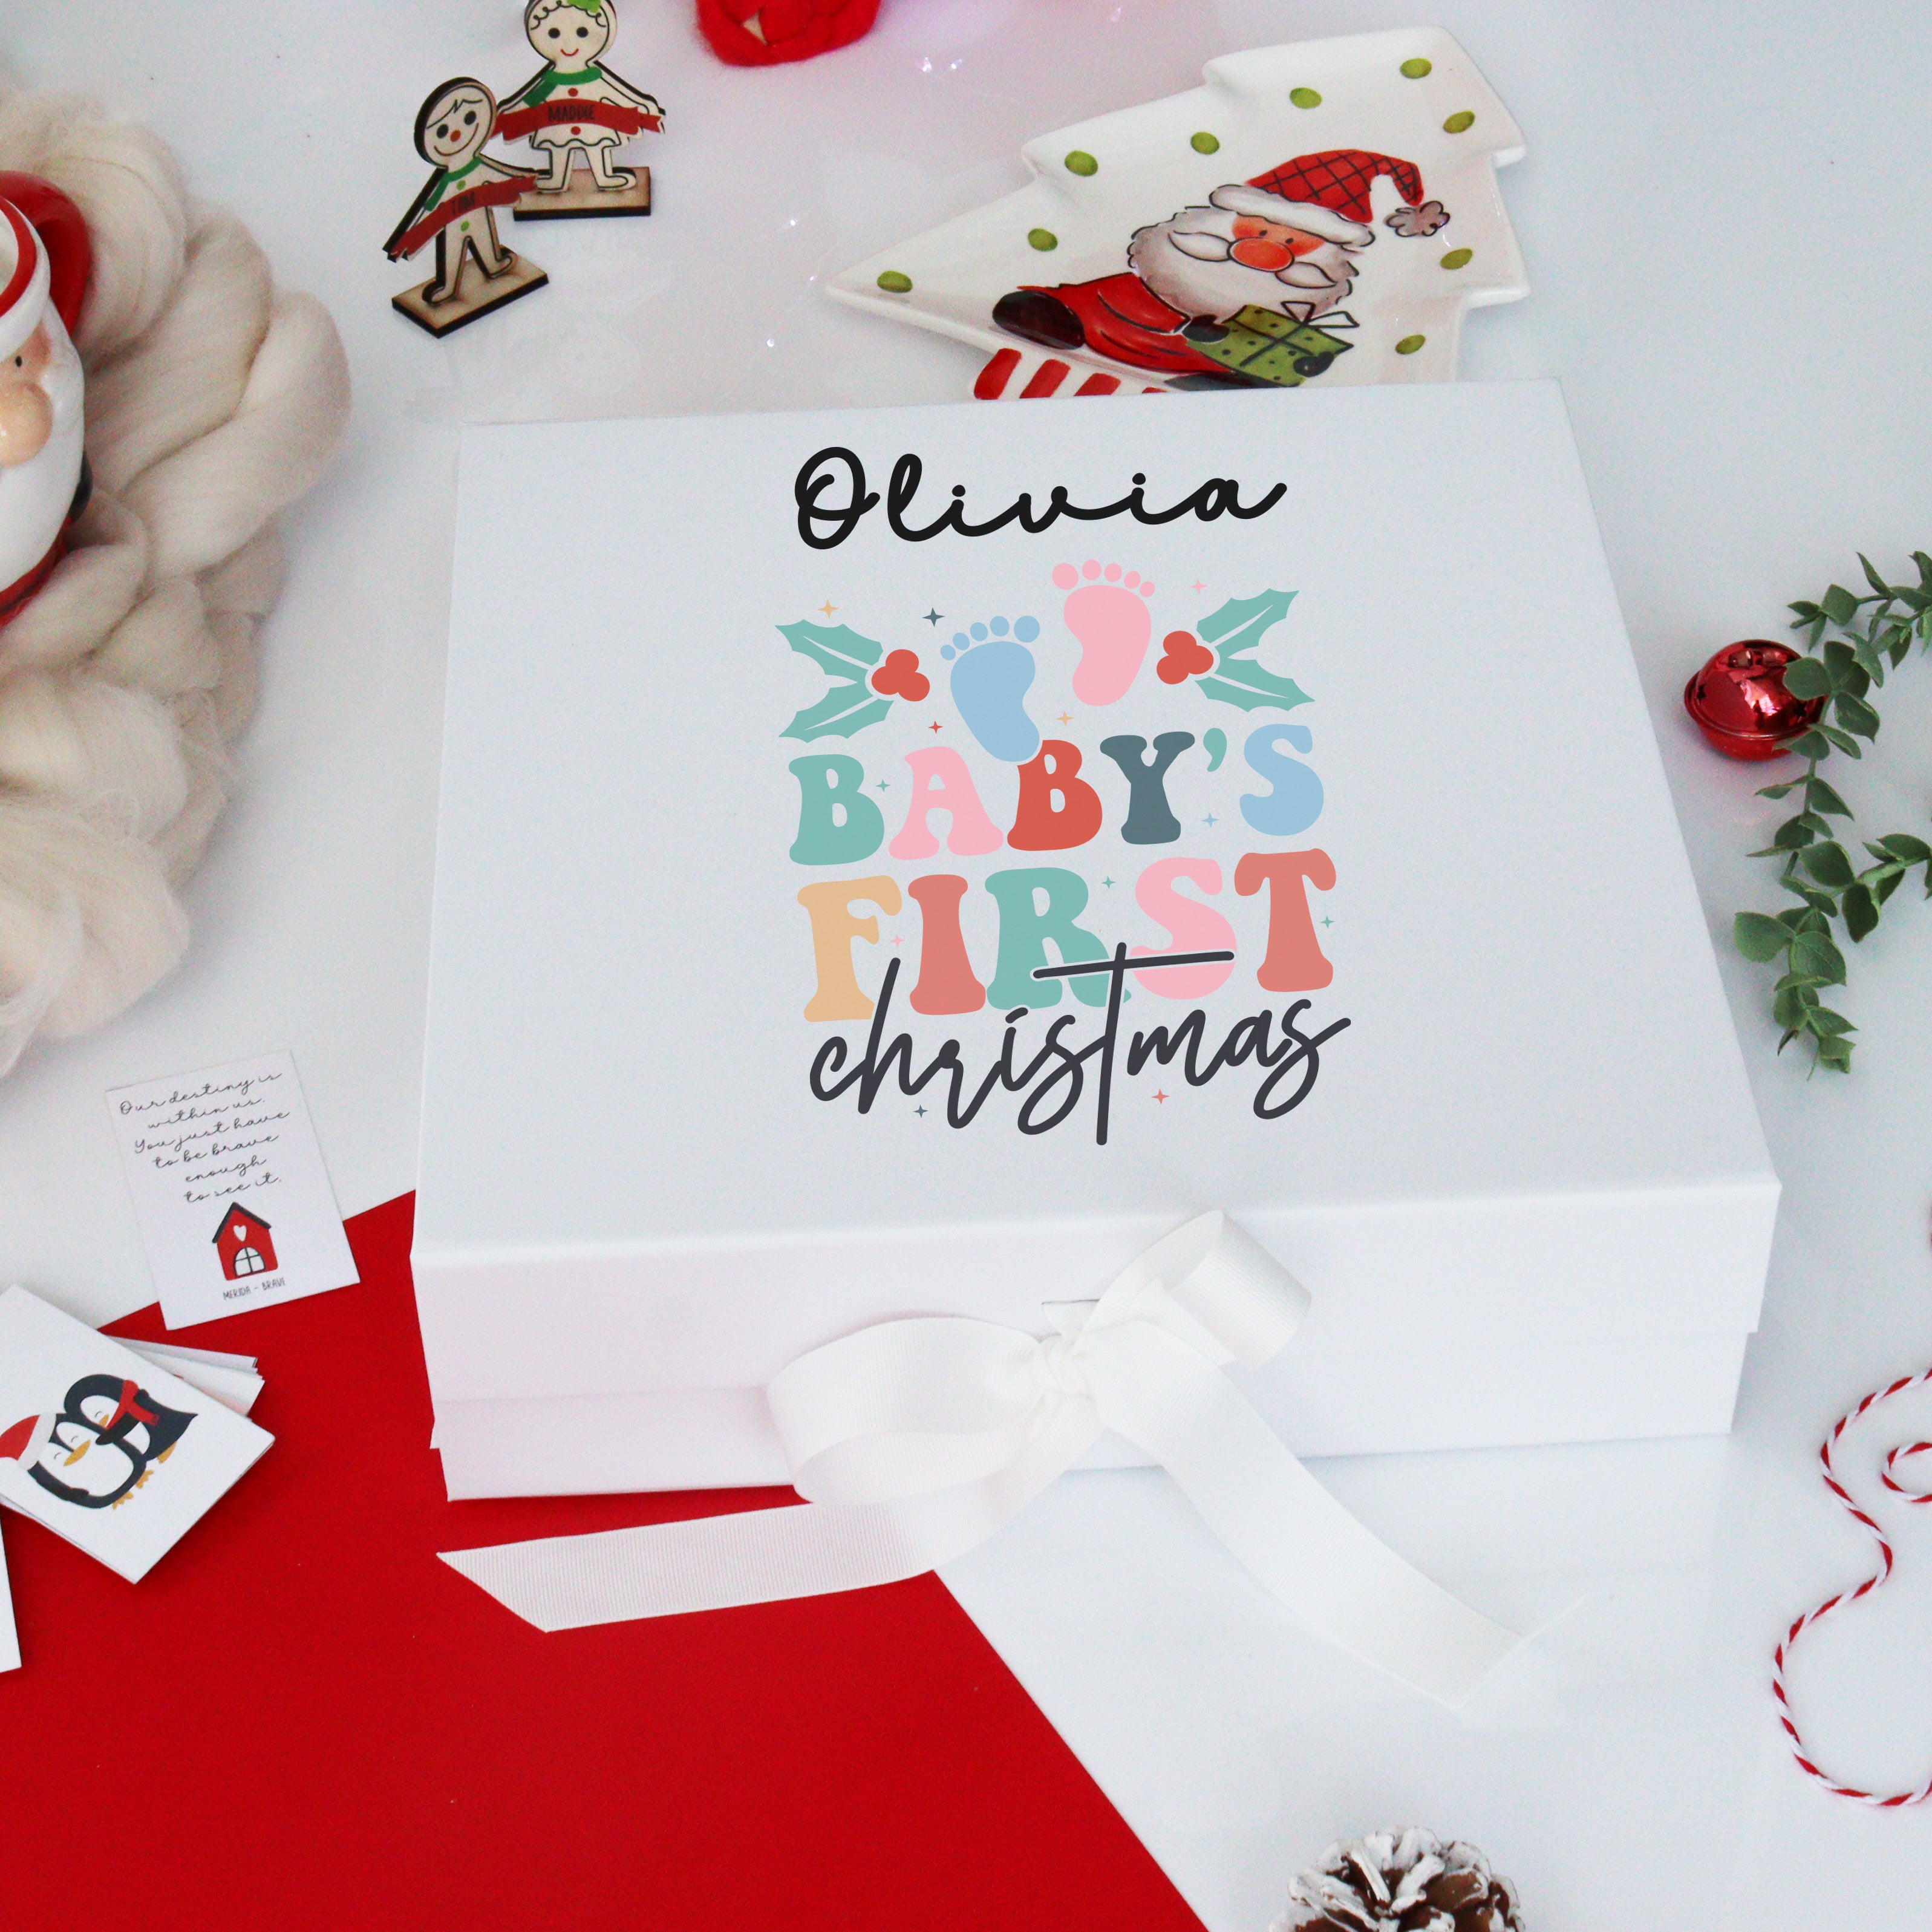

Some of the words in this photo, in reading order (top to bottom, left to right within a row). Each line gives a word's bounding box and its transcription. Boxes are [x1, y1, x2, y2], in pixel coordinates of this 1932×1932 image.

[548, 105, 595, 120] MADDIE
[794, 446, 1287, 550] Olivia
[788, 723, 1324, 866] BABY'S
[797, 847, 1337, 1022] FIRST
[809, 942, 1351, 1146] christmas
[120, 1100, 166, 1115] Our
[169, 1080, 255, 1103] destiny
[258, 1073, 282, 1083] is
[148, 1108, 229, 1129] within
[233, 1098, 266, 1109] us.
[135, 1139, 176, 1154] You
[175, 1122, 230, 1150] just
[234, 1112, 291, 1129] have
[152, 1157, 180, 1168] to
[183, 1150, 207, 1162] be
[212, 1135, 279, 1155] brave
[185, 1155, 267, 1182] enough
[183, 1190, 210, 1203] to
[214, 1184, 251, 1196] see
[255, 1172, 282, 1186] it.
[223, 1286, 251, 1300] MERIDA
[262, 1277, 286, 1290] BRAVE
